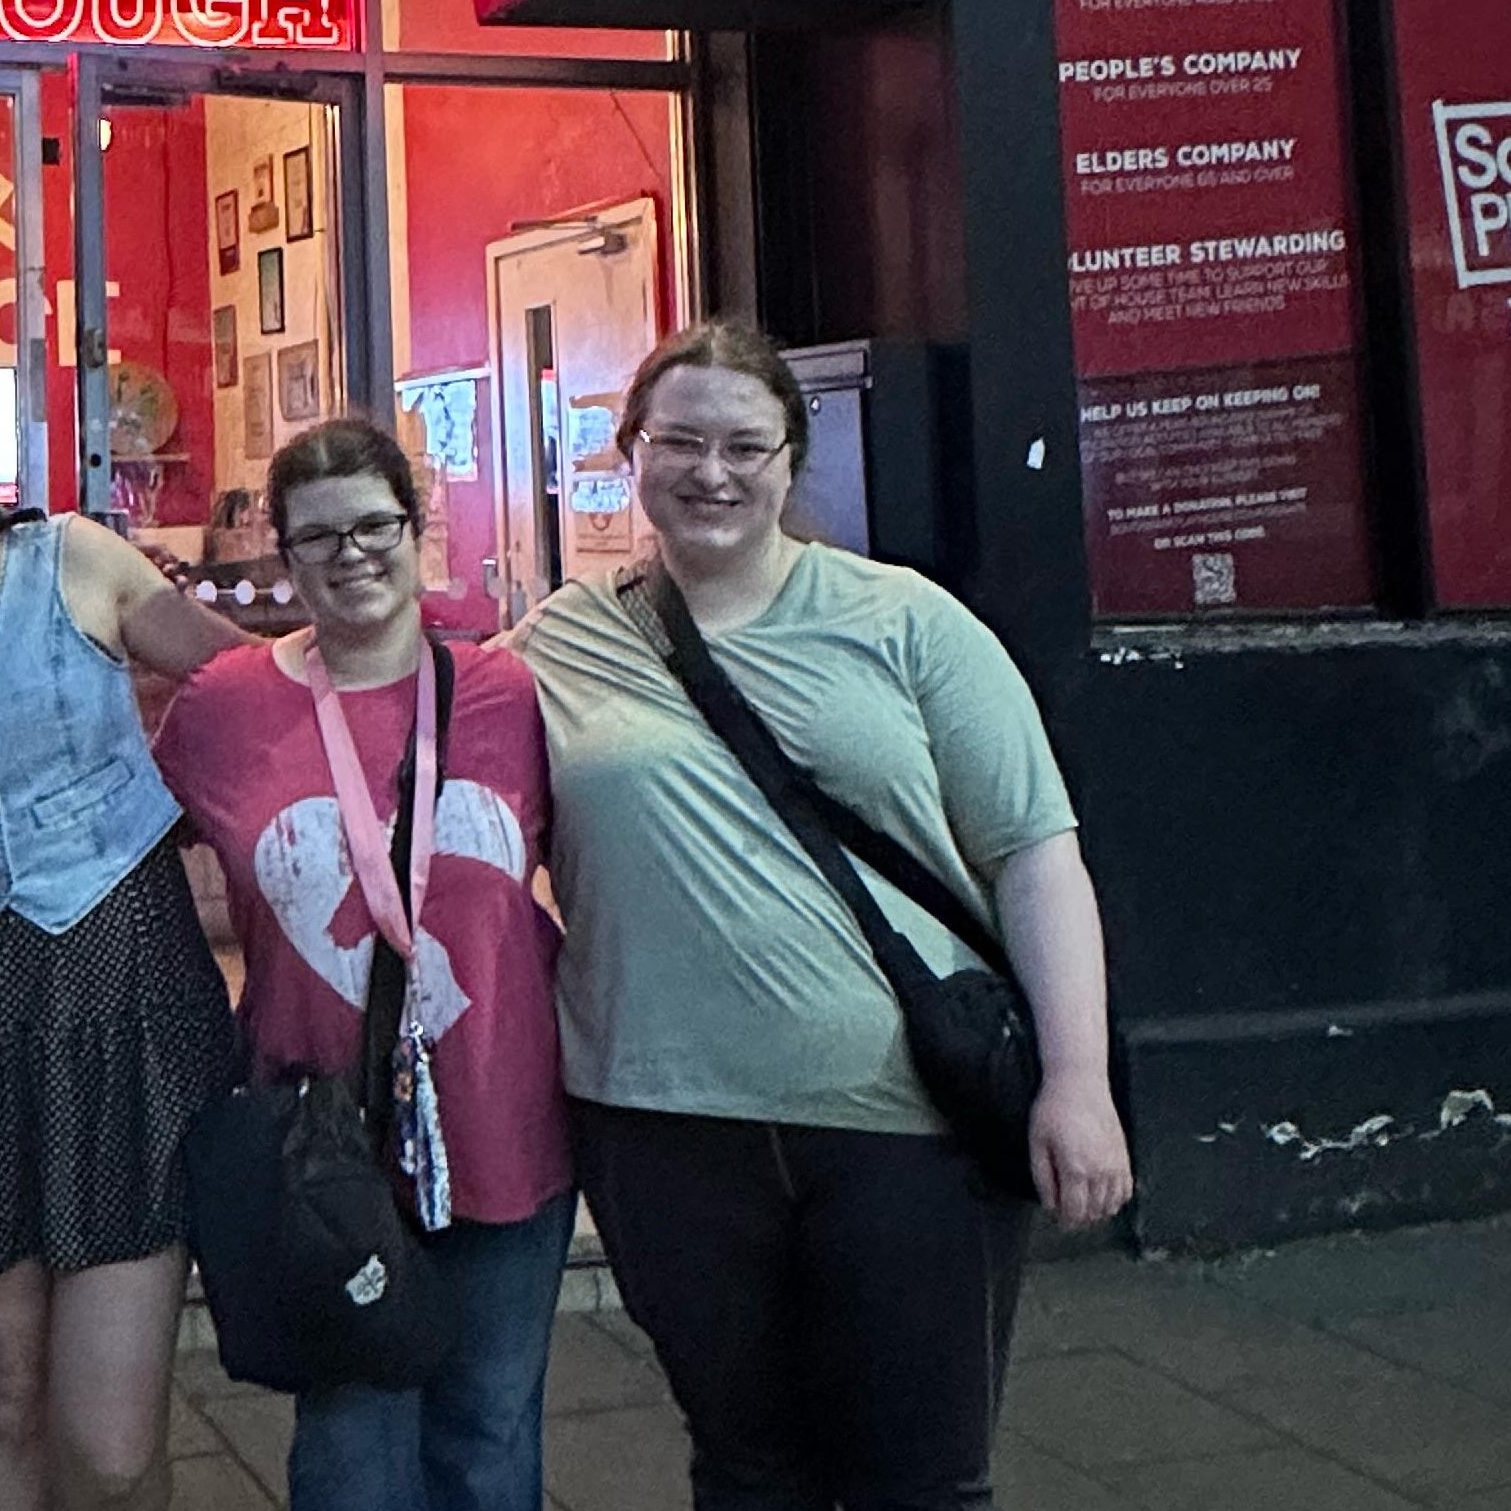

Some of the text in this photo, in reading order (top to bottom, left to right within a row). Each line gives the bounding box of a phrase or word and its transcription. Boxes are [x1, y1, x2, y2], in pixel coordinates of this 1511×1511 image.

[1058, 48, 1302, 83] PEOPLE'S COMPANY
[1092, 85, 1126, 103] FOR
[1128, 81, 1207, 100] EVERYONE
[1209, 77, 1250, 96] OVER
[1076, 138, 1299, 175] ELDERS COMPANY
[1068, 229, 1346, 273] LUNTEER STEWARDING
[1080, 403, 1122, 425] HELP
[1125, 400, 1149, 418] US
[1151, 396, 1193, 415] KEEP
[1194, 393, 1220, 411] ON
[1222, 386, 1289, 407] KEEPING
